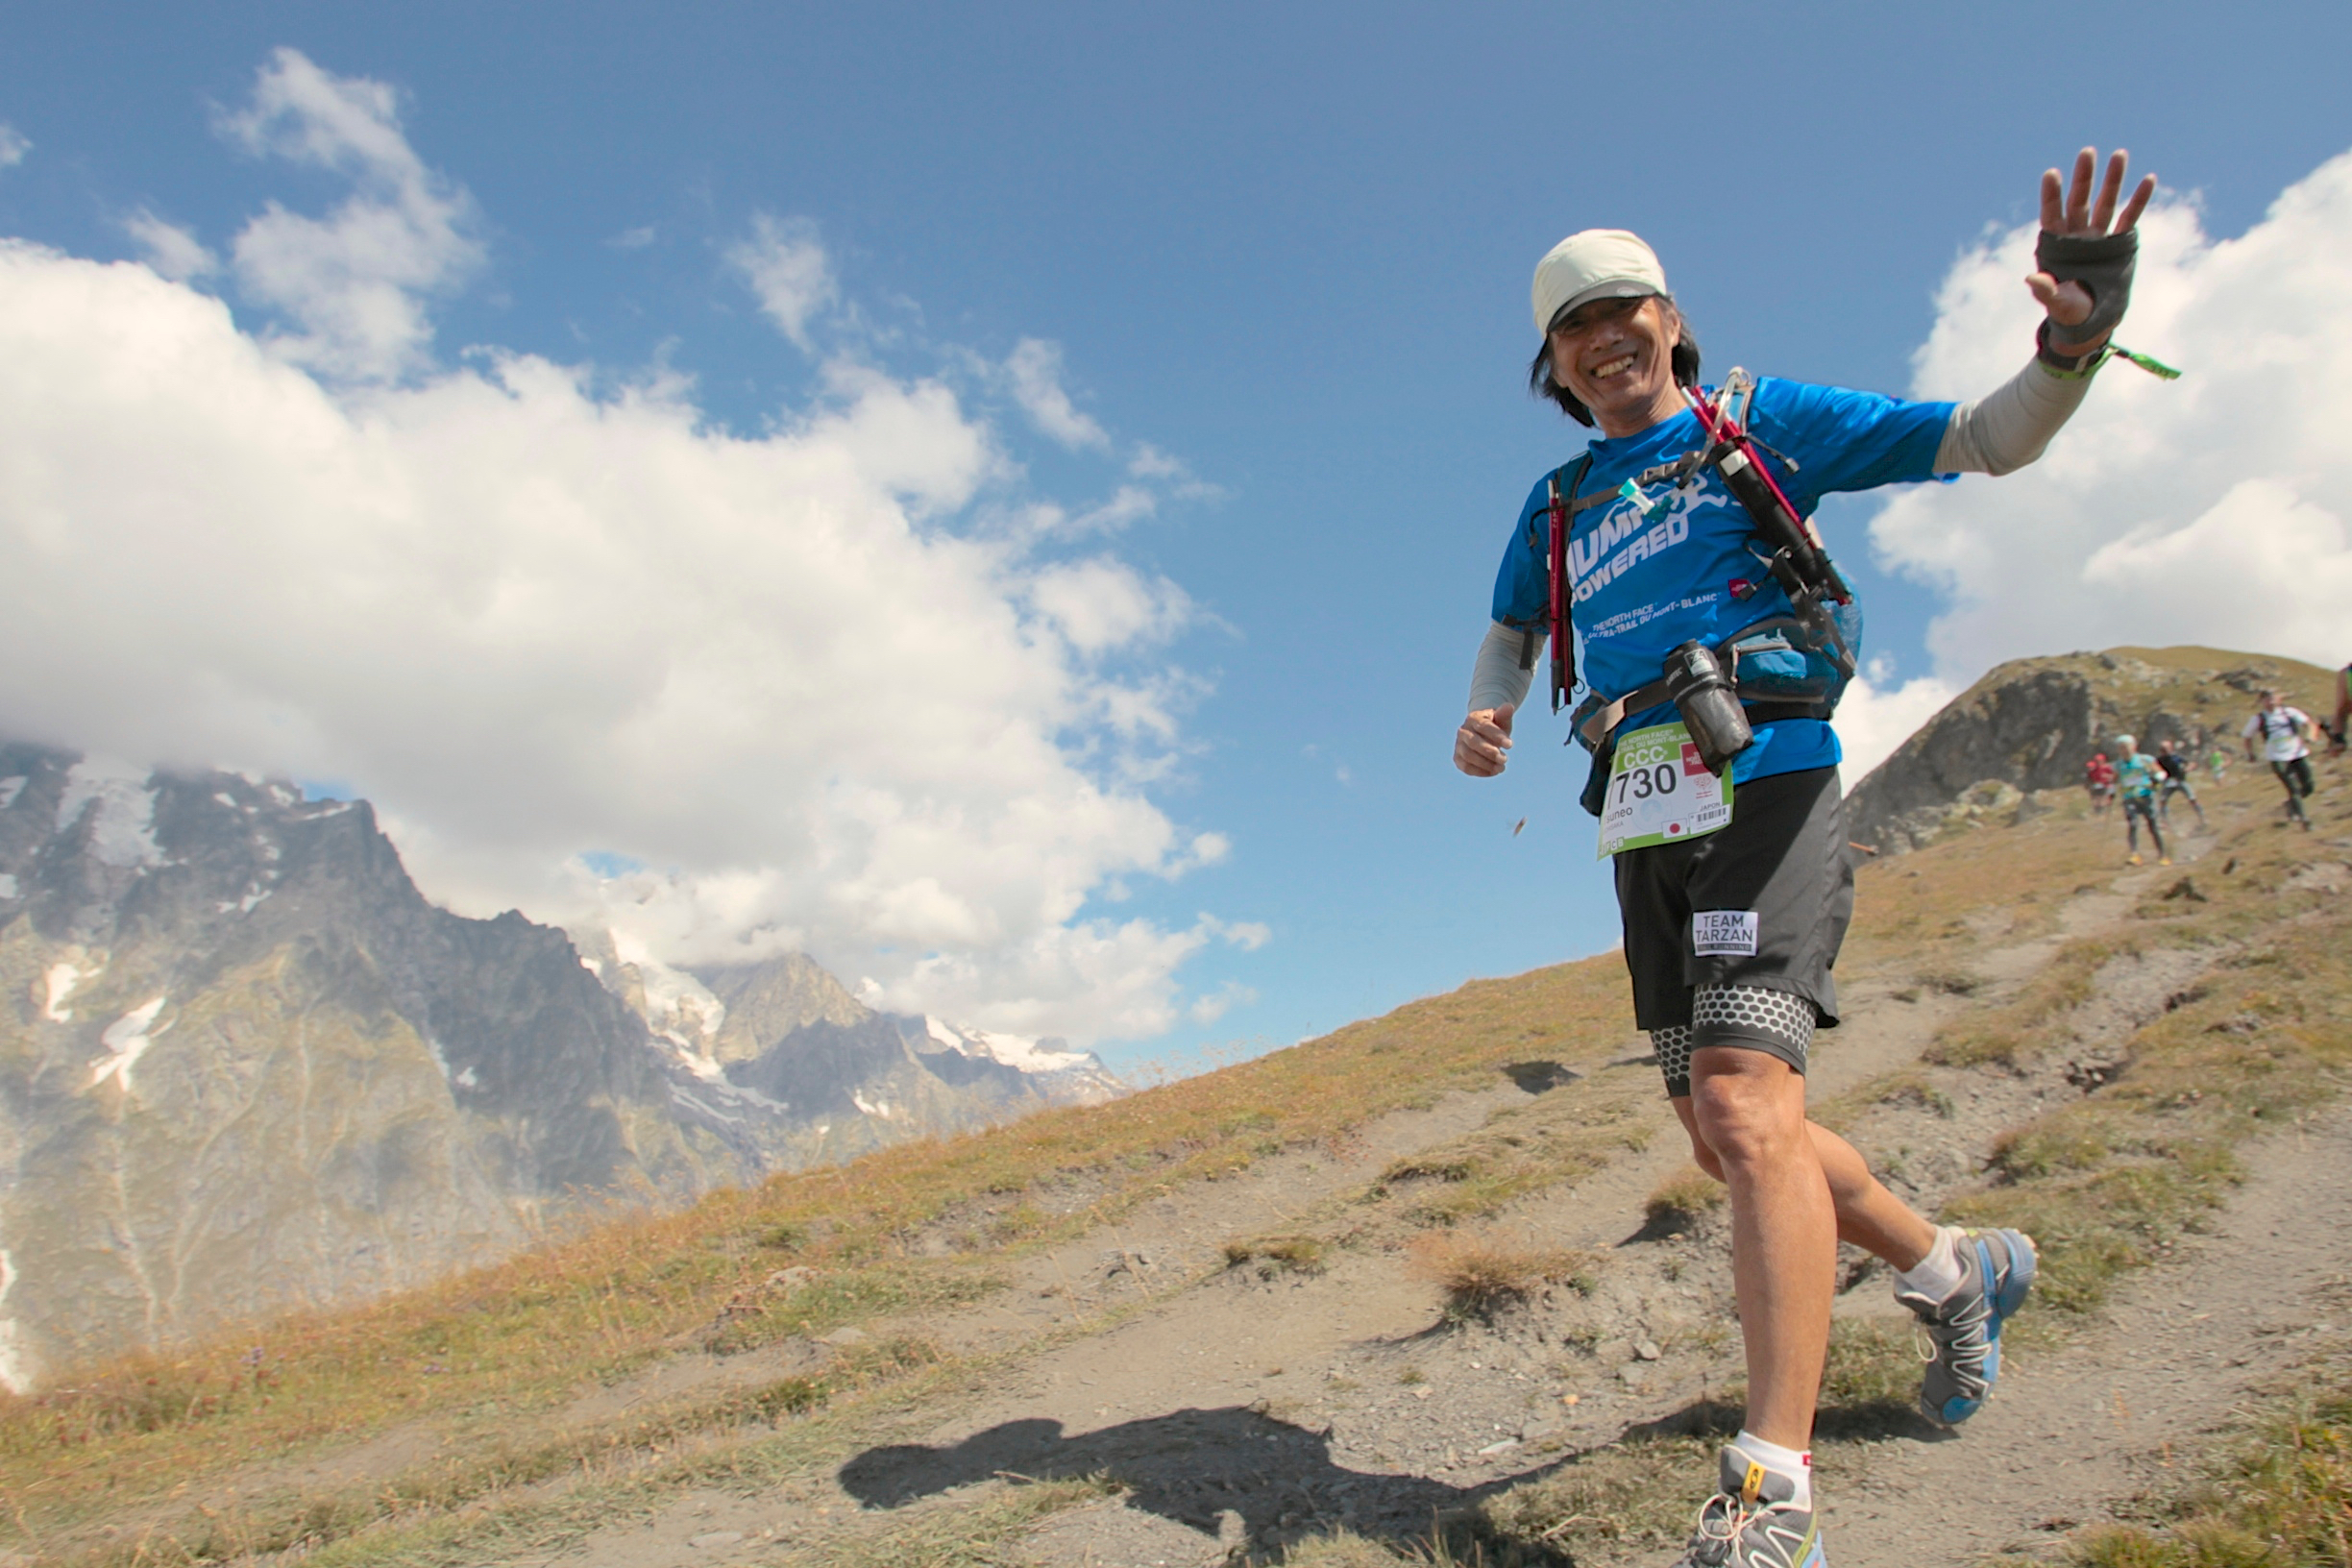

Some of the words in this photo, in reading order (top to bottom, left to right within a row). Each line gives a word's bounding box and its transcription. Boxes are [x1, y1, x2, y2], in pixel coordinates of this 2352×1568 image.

[1592, 621, 1605, 631] THE
[1605, 611, 1631, 627] NORTH
[1632, 603, 1654, 618] FACE
[1588, 620, 1638, 639] ULTRA-TRAIL
[1639, 614, 1652, 625] DU
[1629, 733, 1650, 744] NORTH
[1647, 732, 1691, 746] MONT-BLAN
[1700, 801, 1721, 812] JAPON
[1703, 915, 1744, 927] TEAM
[1696, 929, 1752, 942] TARZAN
